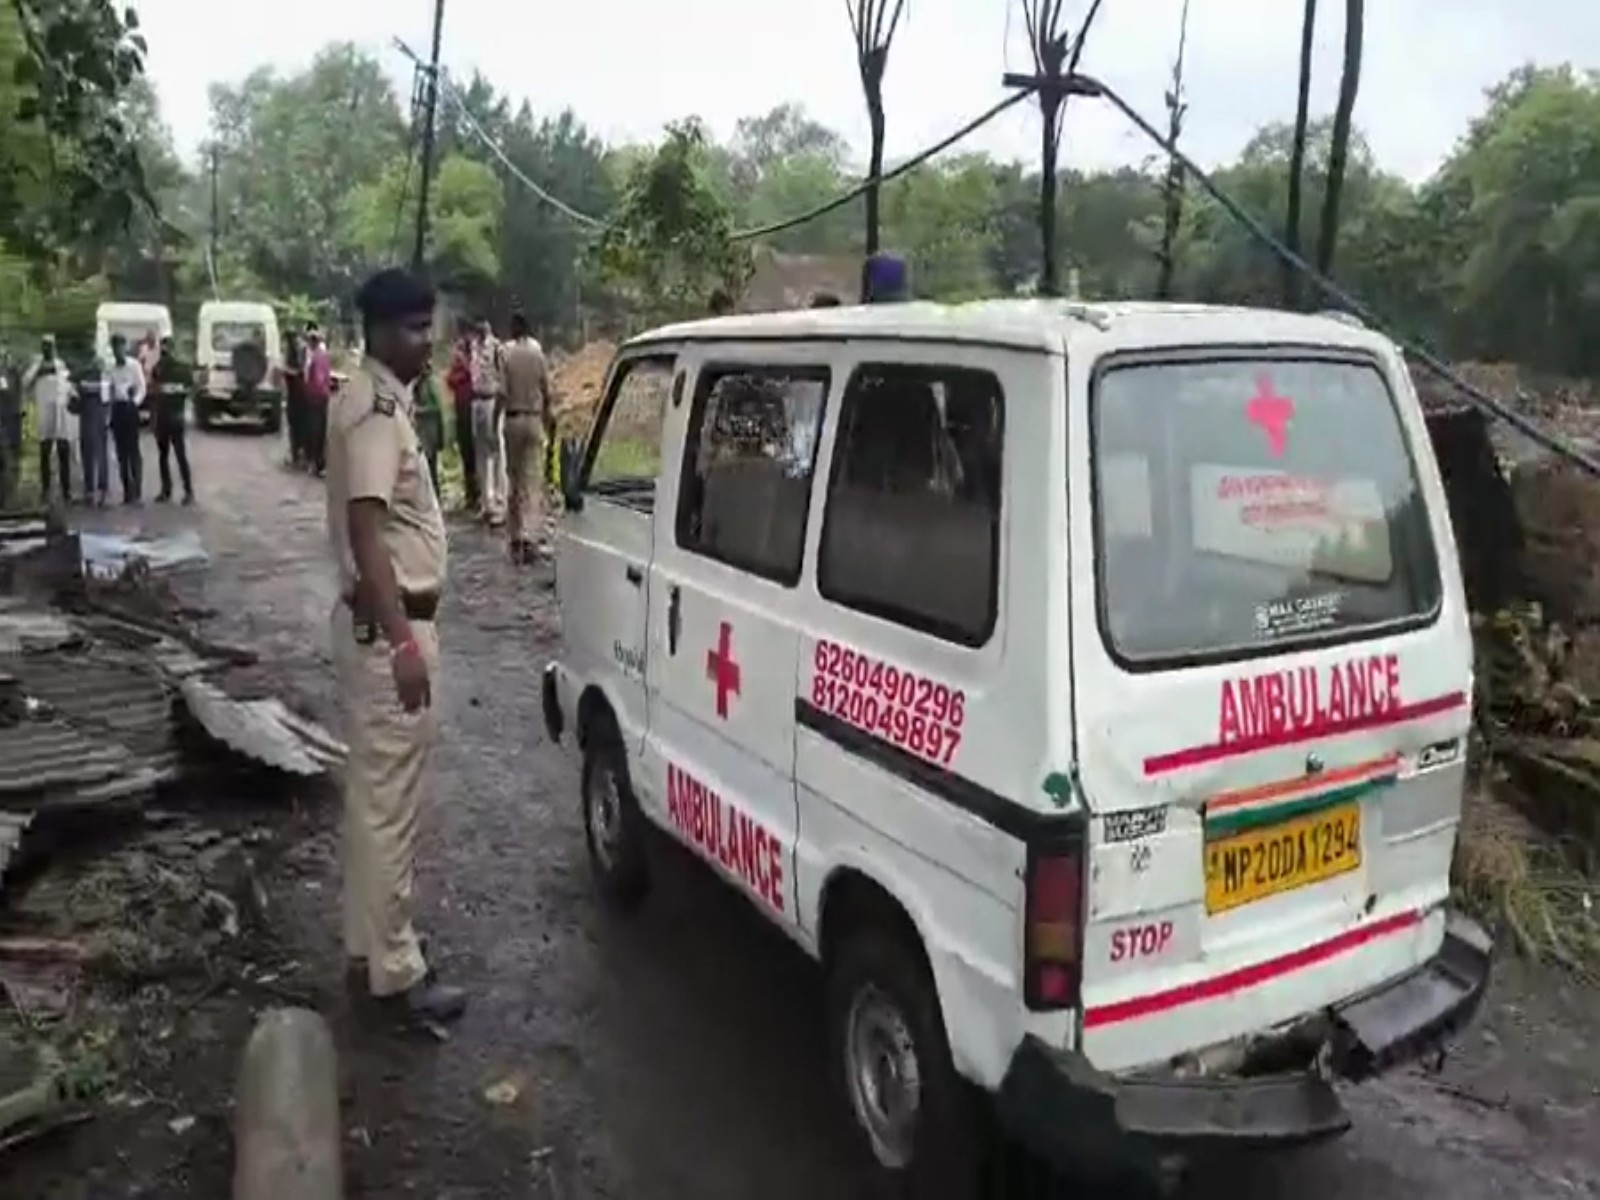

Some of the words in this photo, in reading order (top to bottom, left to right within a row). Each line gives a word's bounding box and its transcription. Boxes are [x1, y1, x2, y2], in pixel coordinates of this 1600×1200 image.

[813, 676, 961, 763] 8120049897
[815, 640, 965, 727] 6260490296
[1220, 655, 1399, 746] AMBULANCE
[668, 762, 784, 912] AMBULANCE
[1110, 922, 1173, 961] STOP
